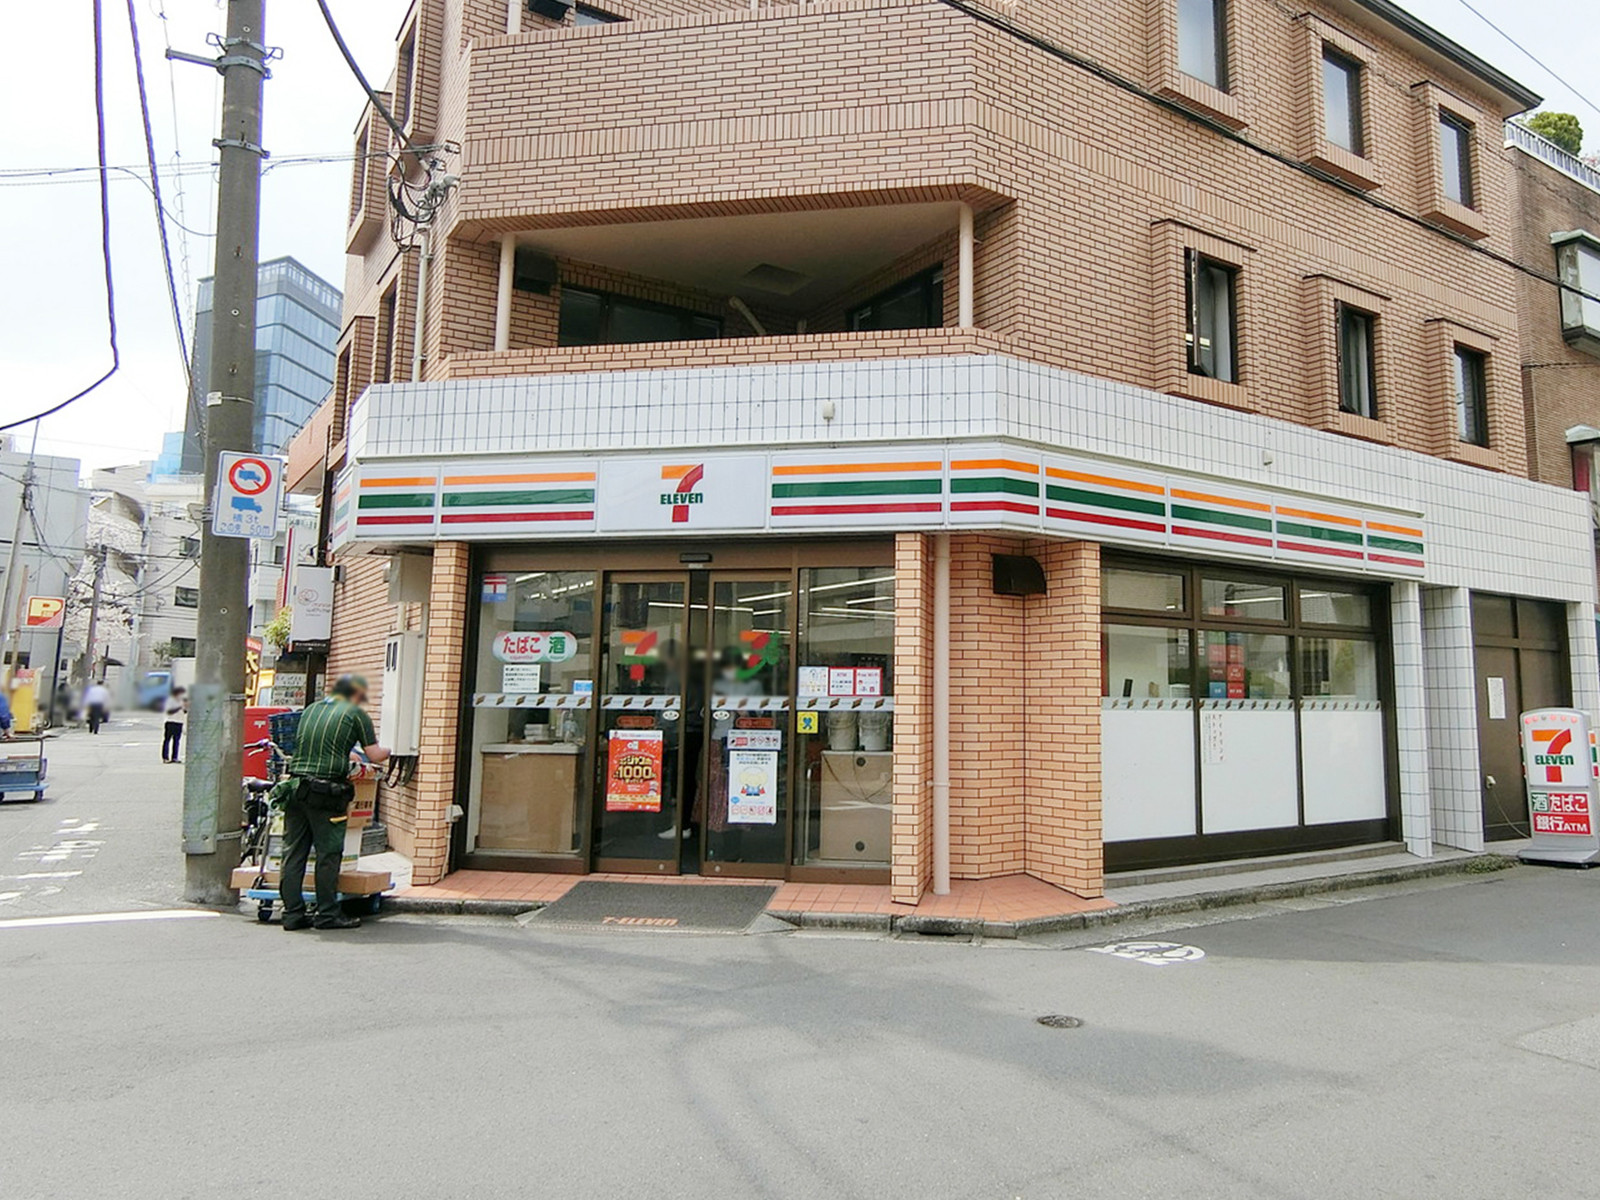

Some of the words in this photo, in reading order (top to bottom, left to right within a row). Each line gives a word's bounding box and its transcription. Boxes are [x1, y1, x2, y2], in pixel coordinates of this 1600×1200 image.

[661, 463, 704, 523] 7
[250, 524, 270, 536] 50m
[503, 636, 541, 654] たばこ
[548, 636, 566, 654] 酒
[1531, 728, 1572, 783] 7
[1532, 793, 1549, 812] 酒
[1549, 794, 1588, 812] たばこ
